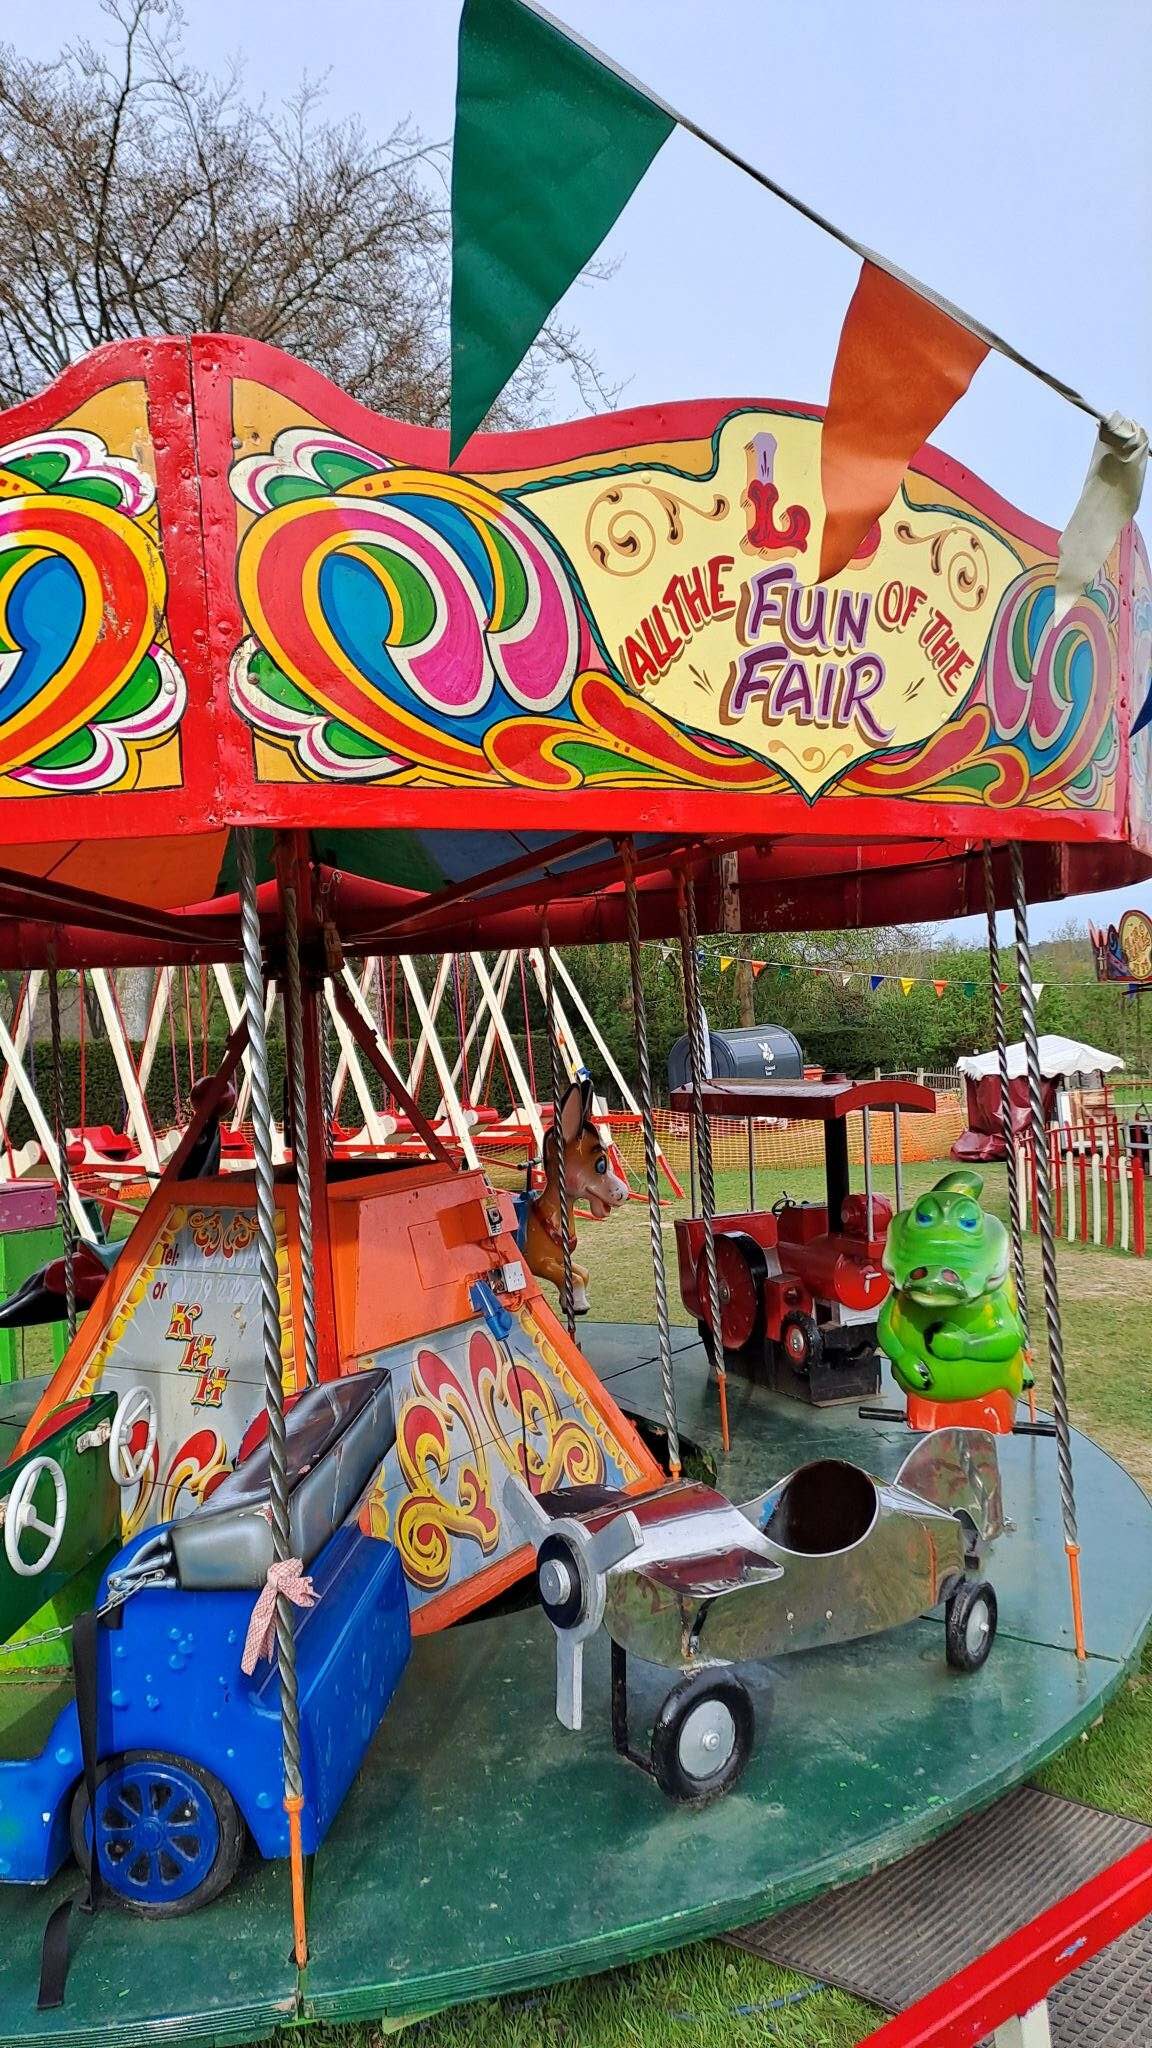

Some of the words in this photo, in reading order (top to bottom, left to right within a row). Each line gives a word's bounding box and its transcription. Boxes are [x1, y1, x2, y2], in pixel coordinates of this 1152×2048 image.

[623, 604, 684, 687] ALL
[662, 554, 737, 637] THE
[745, 561, 874, 651] FUN
[882, 580, 929, 627] OF
[922, 608, 976, 694] THE
[728, 641, 897, 742] FAIR
[152, 1280, 168, 1301] or
